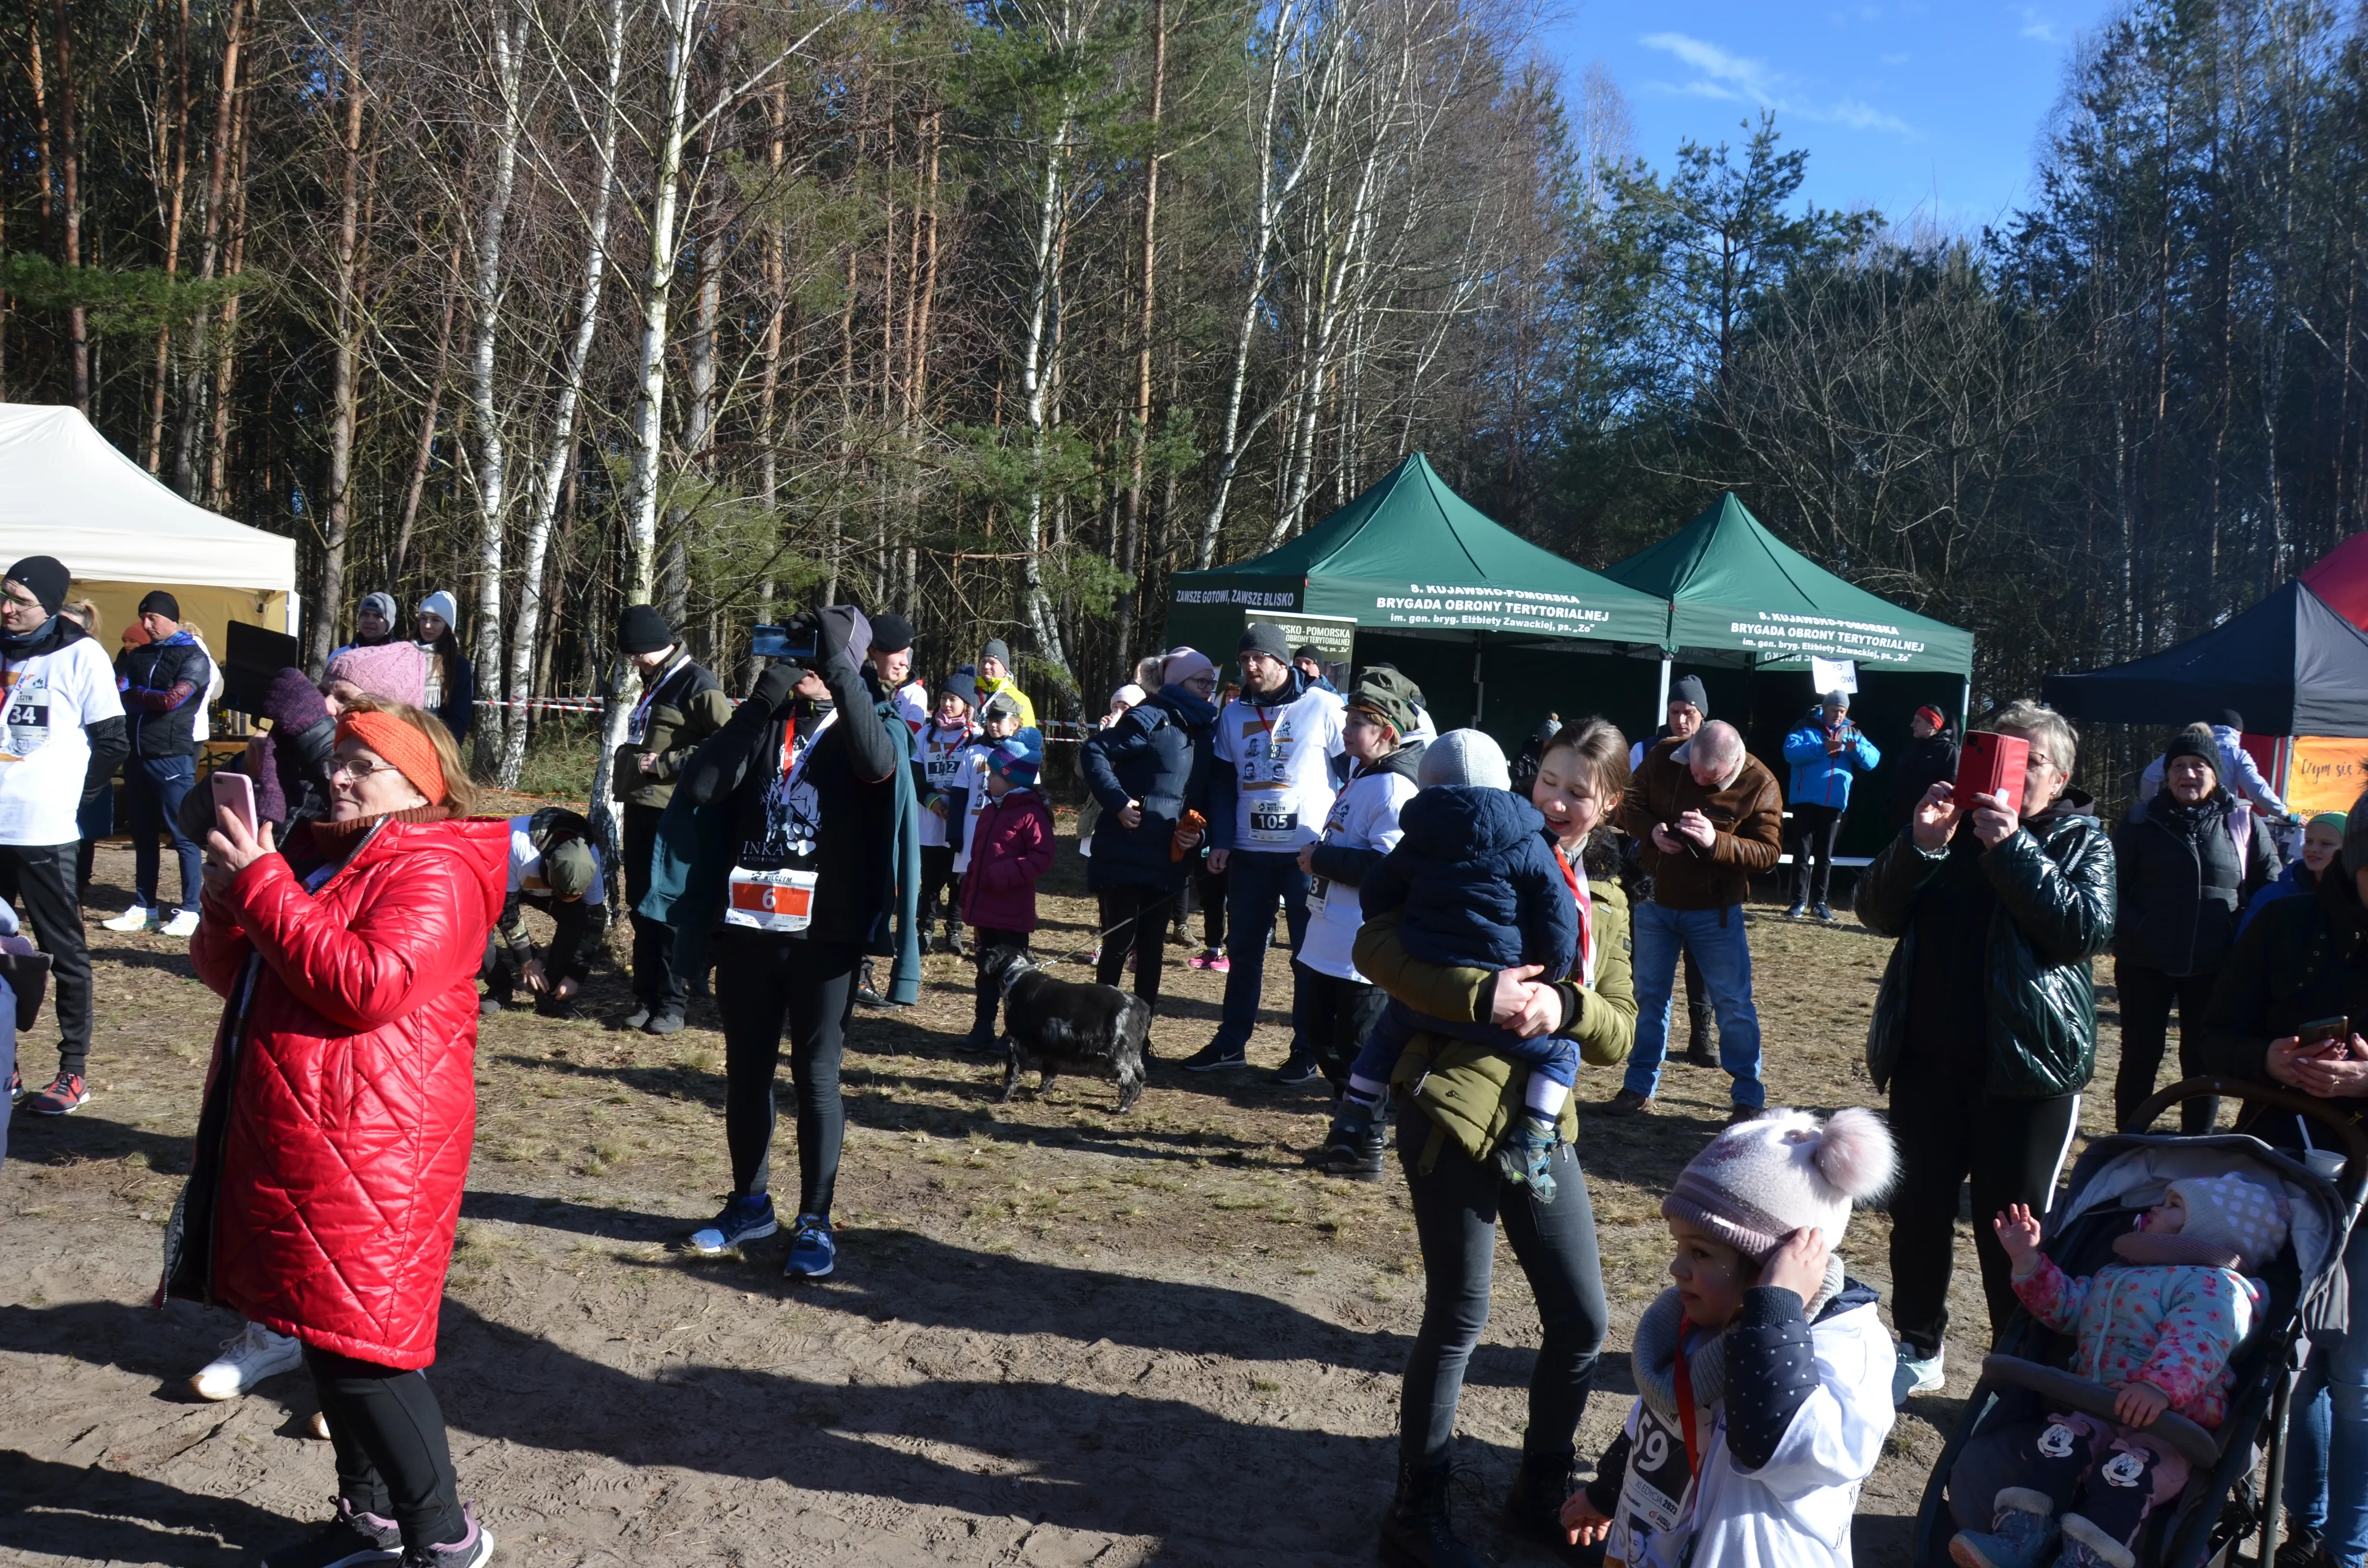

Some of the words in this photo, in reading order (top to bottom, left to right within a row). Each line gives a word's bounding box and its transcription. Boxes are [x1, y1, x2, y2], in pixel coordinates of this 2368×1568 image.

[1176, 590, 1201, 603] ZAWSZE
[1202, 589, 1230, 605] GOTOWI,
[1232, 589, 1263, 606] ZAWSZE
[1263, 592, 1294, 607] BLISKO
[1410, 584, 1424, 593] 8.
[1426, 585, 1580, 604] KUJAWSKO-POMORSKA
[1377, 597, 1442, 610] BRYGADA
[1444, 600, 1502, 612] OBRONY
[1505, 602, 1609, 622] TERYTORIALNEJ
[1390, 613, 1406, 622] im.
[1408, 615, 1431, 624] gen.
[1433, 614, 1459, 625] bryg.
[1461, 613, 1501, 626] Elżbiety
[1503, 617, 1555, 631] Zawackiej,
[1558, 624, 1572, 632] ps.
[1771, 612, 1899, 635] KUJAWSKO-POMORSKA
[1285, 634, 1308, 643] OBRONY
[1309, 636, 1350, 646] TERYTORIALNEJ
[1306, 627, 1350, 638] POMORSKA
[1731, 622, 1785, 637] BRYGADA
[1788, 627, 1836, 640] OBRONY
[1838, 632, 1924, 652] TERYTORIALNEJ
[1742, 637, 1756, 646] im.
[1758, 640, 1776, 648] gen.
[1778, 640, 1800, 651] bryg.
[1802, 642, 1835, 653] Elżbiety
[1836, 645, 1879, 659] Zawackiej,
[11, 706, 37, 724] 34
[2302, 759, 2330, 784] Czym
[2337, 761, 2352, 778] się
[1259, 815, 1287, 829] 105
[742, 841, 785, 856] INKA
[764, 875, 793, 883] WILCZYM
[762, 888, 777, 909] 6
[1635, 1480, 1642, 1488] XI
[1641, 1484, 1663, 1504] EDYCJA
[1663, 1499, 1677, 1515] 2023
